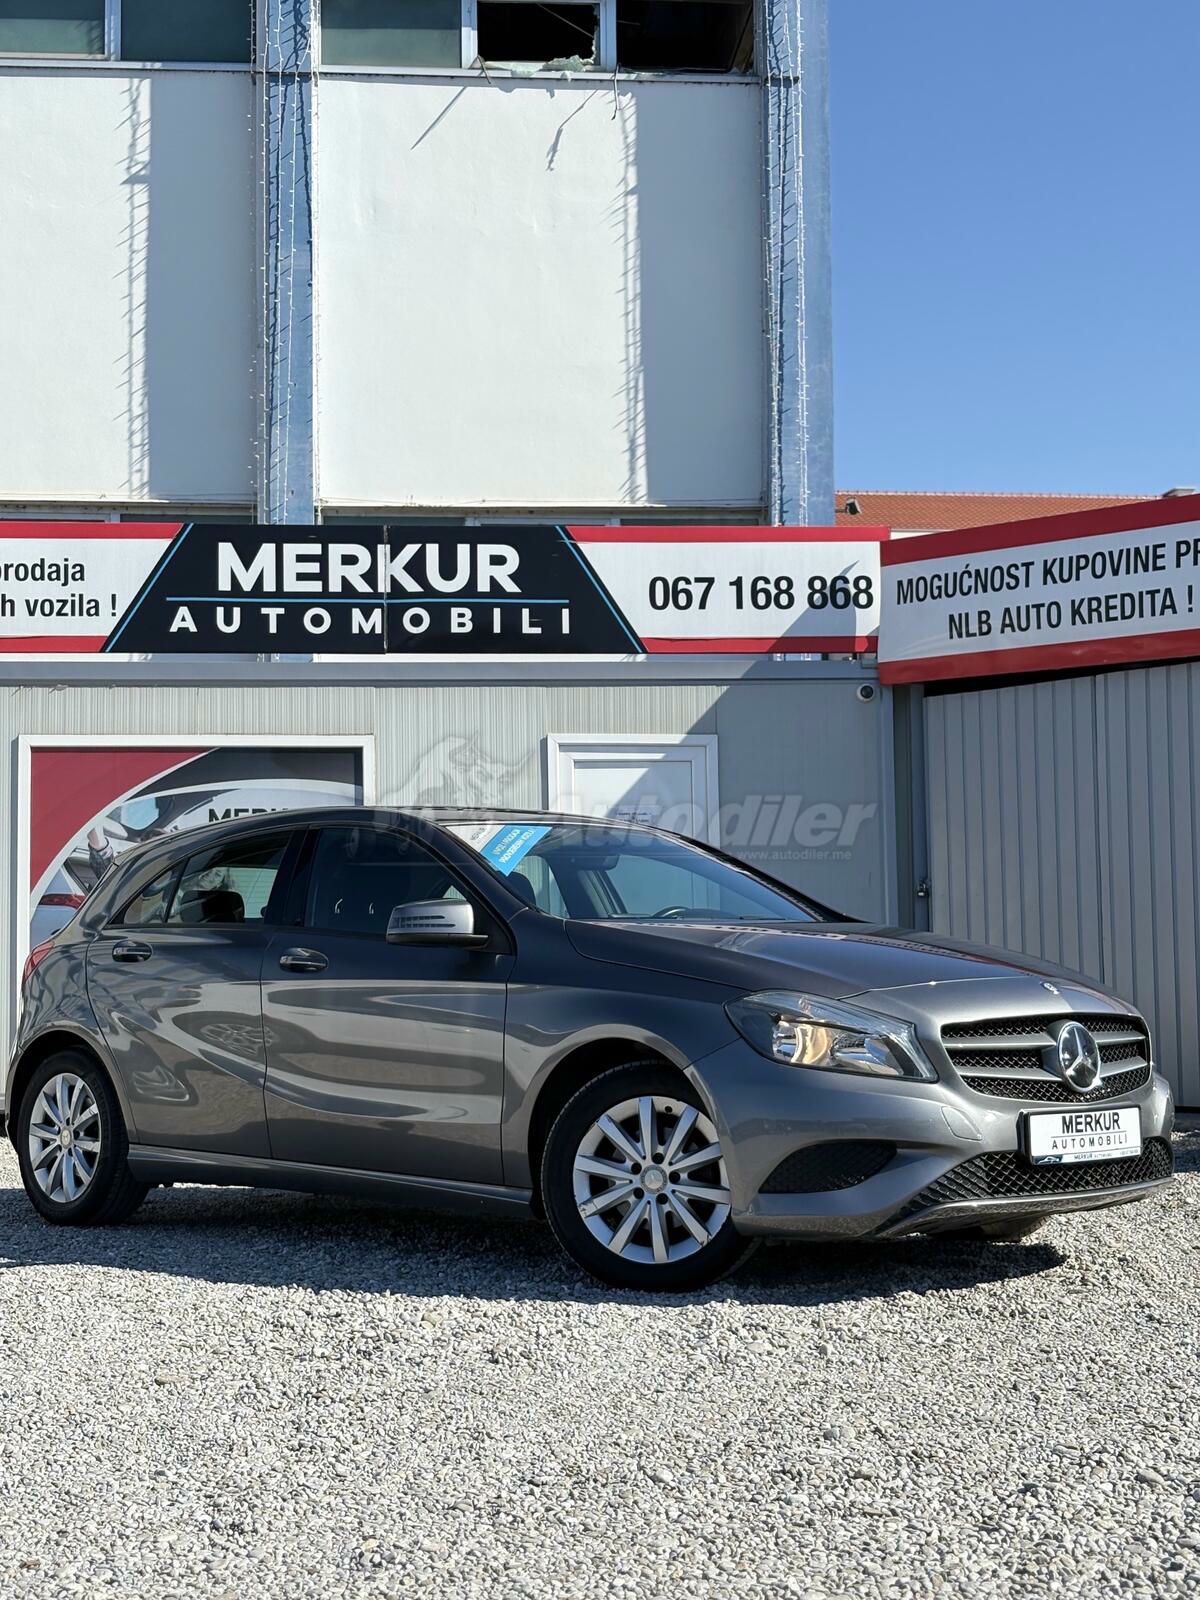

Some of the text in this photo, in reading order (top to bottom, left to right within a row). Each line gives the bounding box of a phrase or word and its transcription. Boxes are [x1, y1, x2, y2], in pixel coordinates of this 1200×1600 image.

[0, 557, 85, 587] rodaja
[217, 541, 522, 593] MERKUR
[896, 562, 1035, 605] MOGUĆNOST
[1042, 542, 1166, 586] KUPOVINE
[24, 593, 100, 618] vozila
[648, 575, 874, 611] 067 168 868
[169, 606, 570, 635] AUTOMOBILI
[948, 609, 992, 640] NLB
[1000, 602, 1062, 634] AUTO
[1070, 588, 1178, 626] KREDITA
[1061, 1112, 1121, 1134] MERKUR
[1051, 1133, 1128, 1150] AUTOMOBILI
